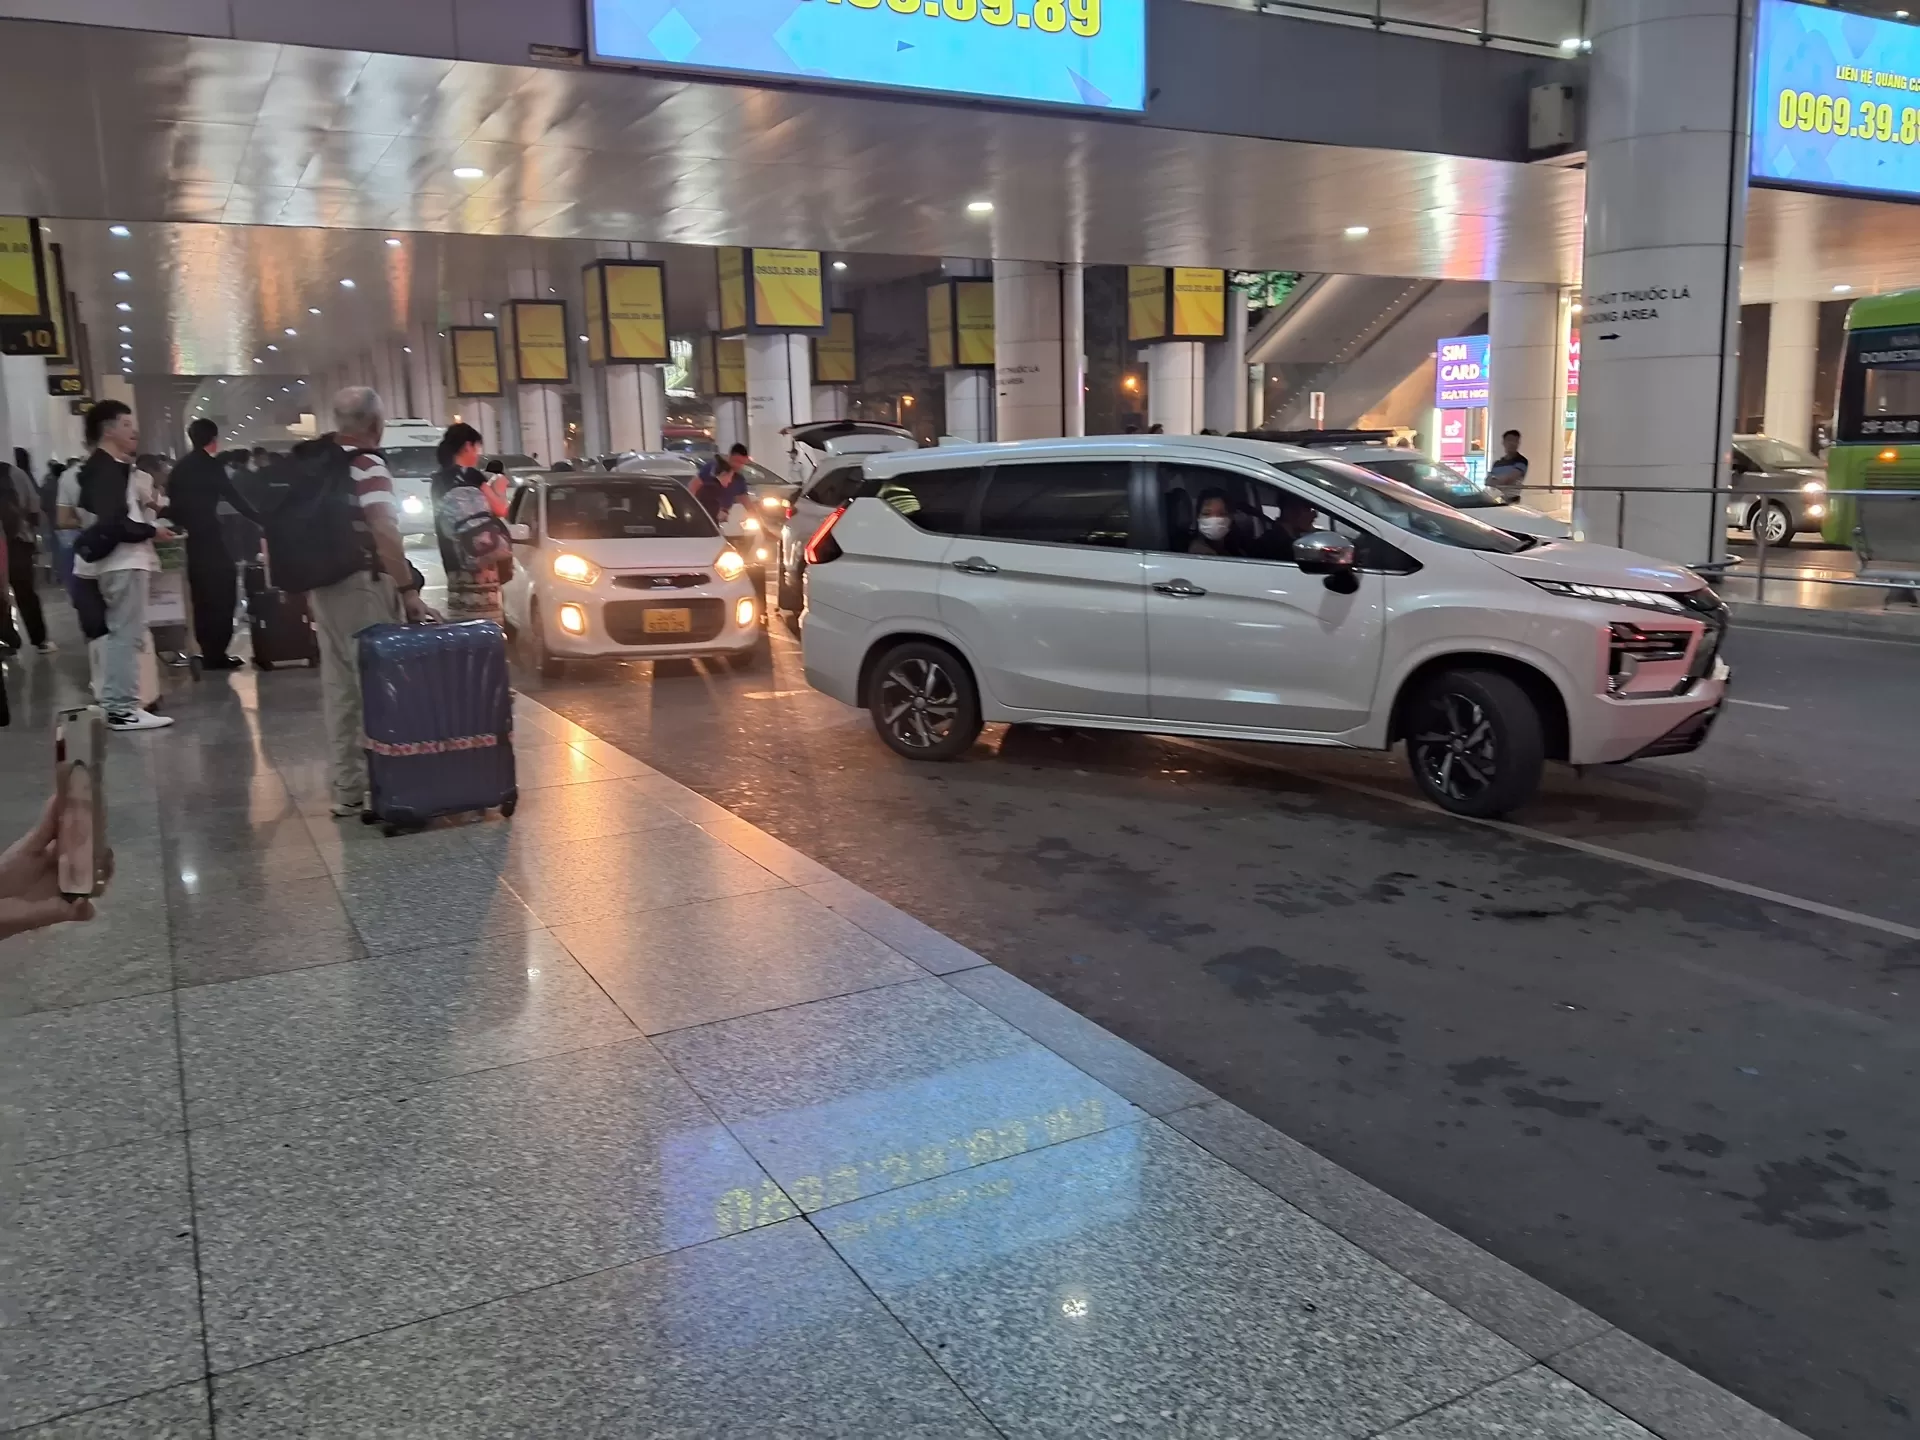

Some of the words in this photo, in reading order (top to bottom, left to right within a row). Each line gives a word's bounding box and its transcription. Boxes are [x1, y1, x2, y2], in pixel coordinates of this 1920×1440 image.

[1835, 65, 1858, 82] LIÊN
[1860, 68, 1873, 88] HỆ
[1875, 69, 1907, 90] QUẢNG
[1778, 88, 1920, 145] 0969.39.8
[1621, 308, 1659, 321] AREA
[22, 329, 51, 348] 10
[1441, 344, 1467, 361] SIM
[1440, 363, 1480, 381] CARD
